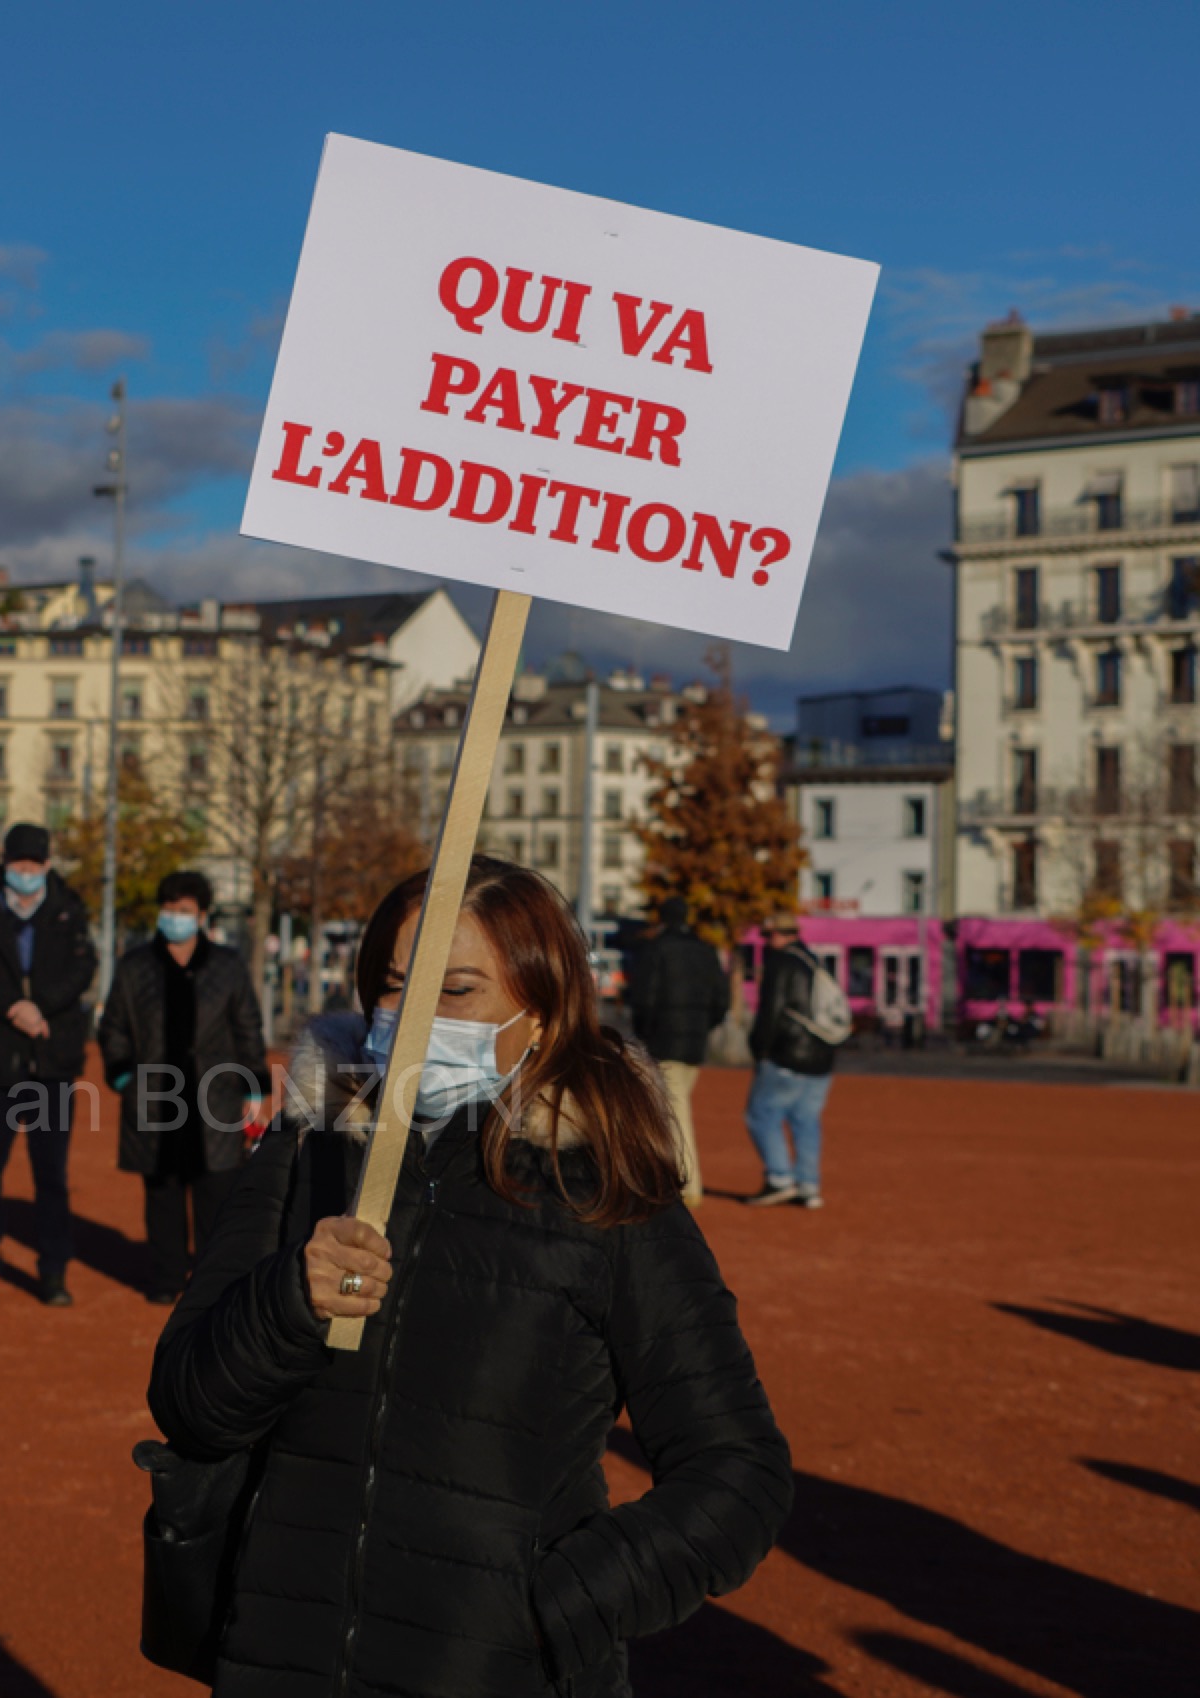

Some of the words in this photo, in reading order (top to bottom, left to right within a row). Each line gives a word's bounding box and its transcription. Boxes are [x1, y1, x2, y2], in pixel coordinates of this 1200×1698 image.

[438, 256, 593, 344] QUI
[611, 291, 713, 374] VA
[419, 351, 687, 467] PAYER
[271, 421, 791, 587] L’ADDITION?
